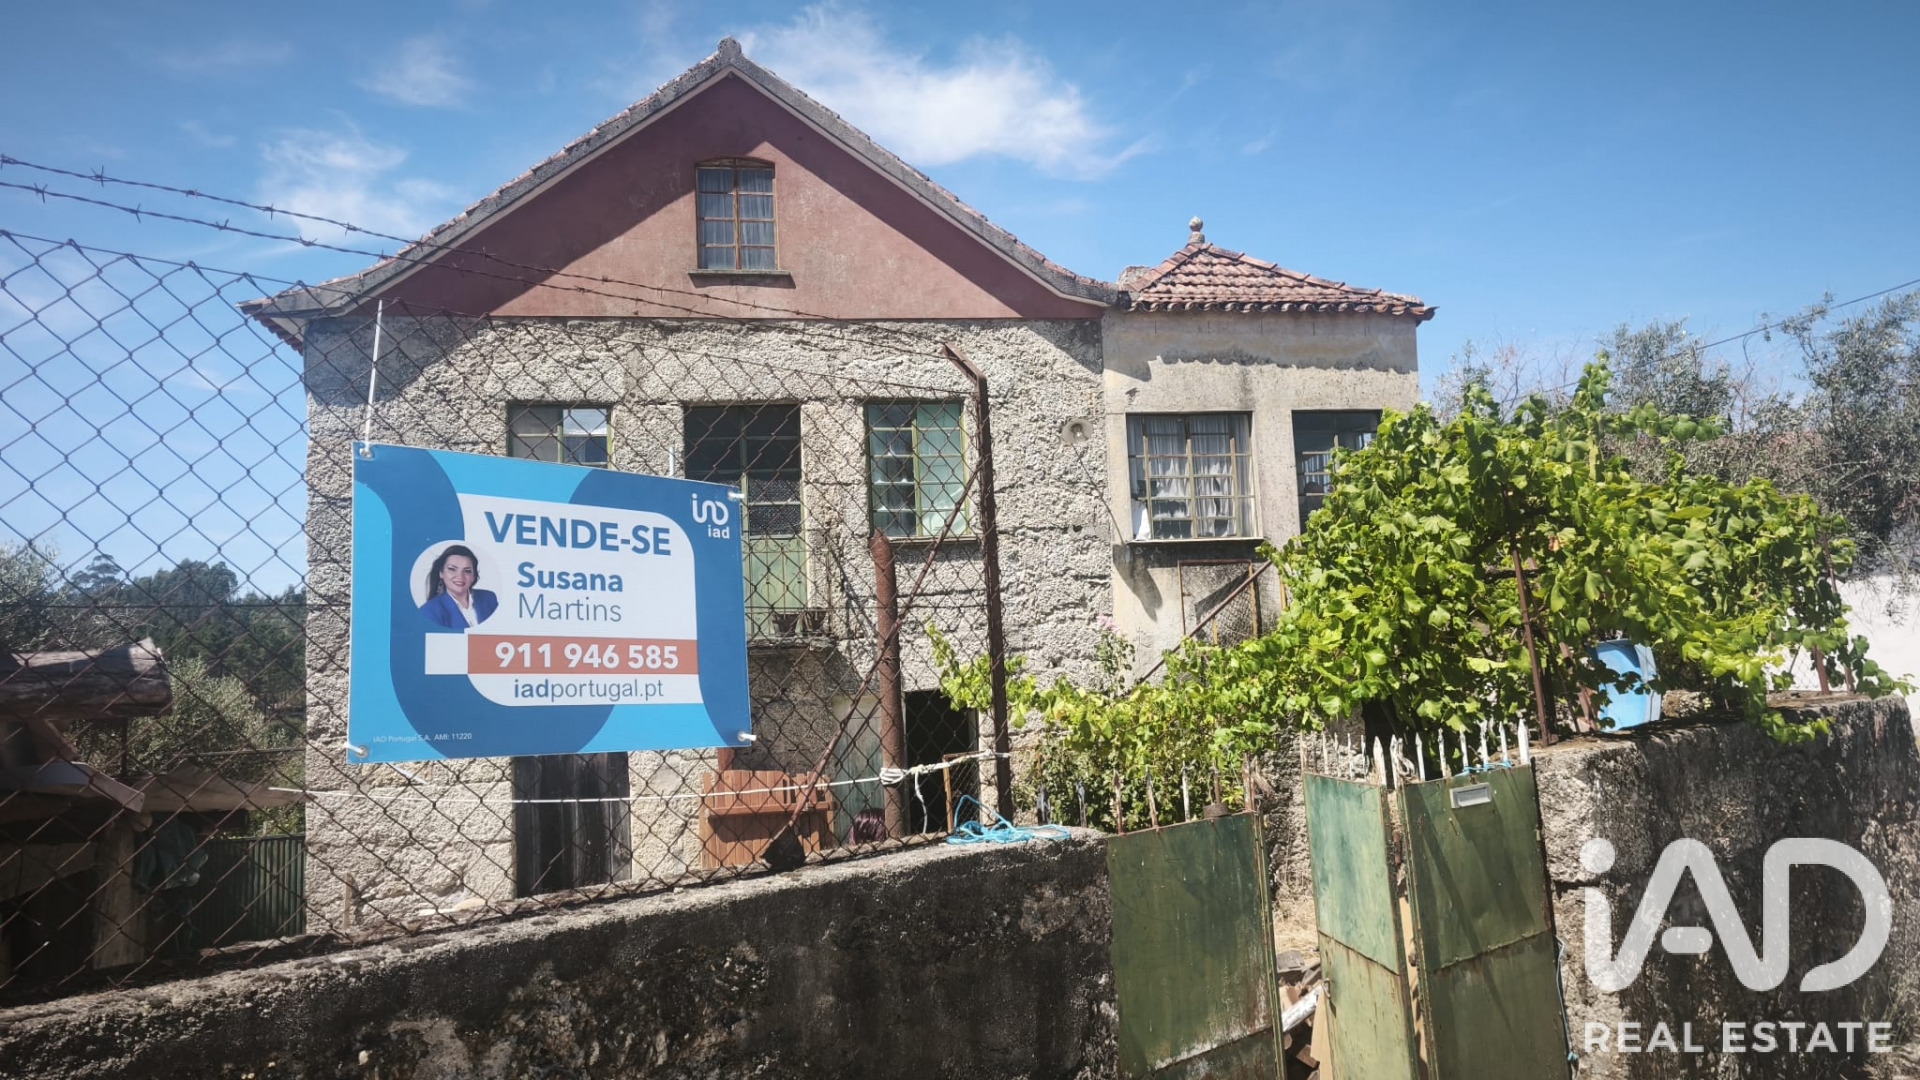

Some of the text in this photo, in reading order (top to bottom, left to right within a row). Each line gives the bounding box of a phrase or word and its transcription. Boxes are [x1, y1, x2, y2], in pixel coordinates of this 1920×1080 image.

[484, 511, 671, 556] VENDE-SE
[708, 524, 730, 539] iad
[517, 561, 623, 592] Susana
[518, 592, 622, 622] Martins
[495, 641, 679, 669] 911 946 585
[513, 678, 664, 702] iadportugal.pt
[388, 734, 416, 743] Portugal
